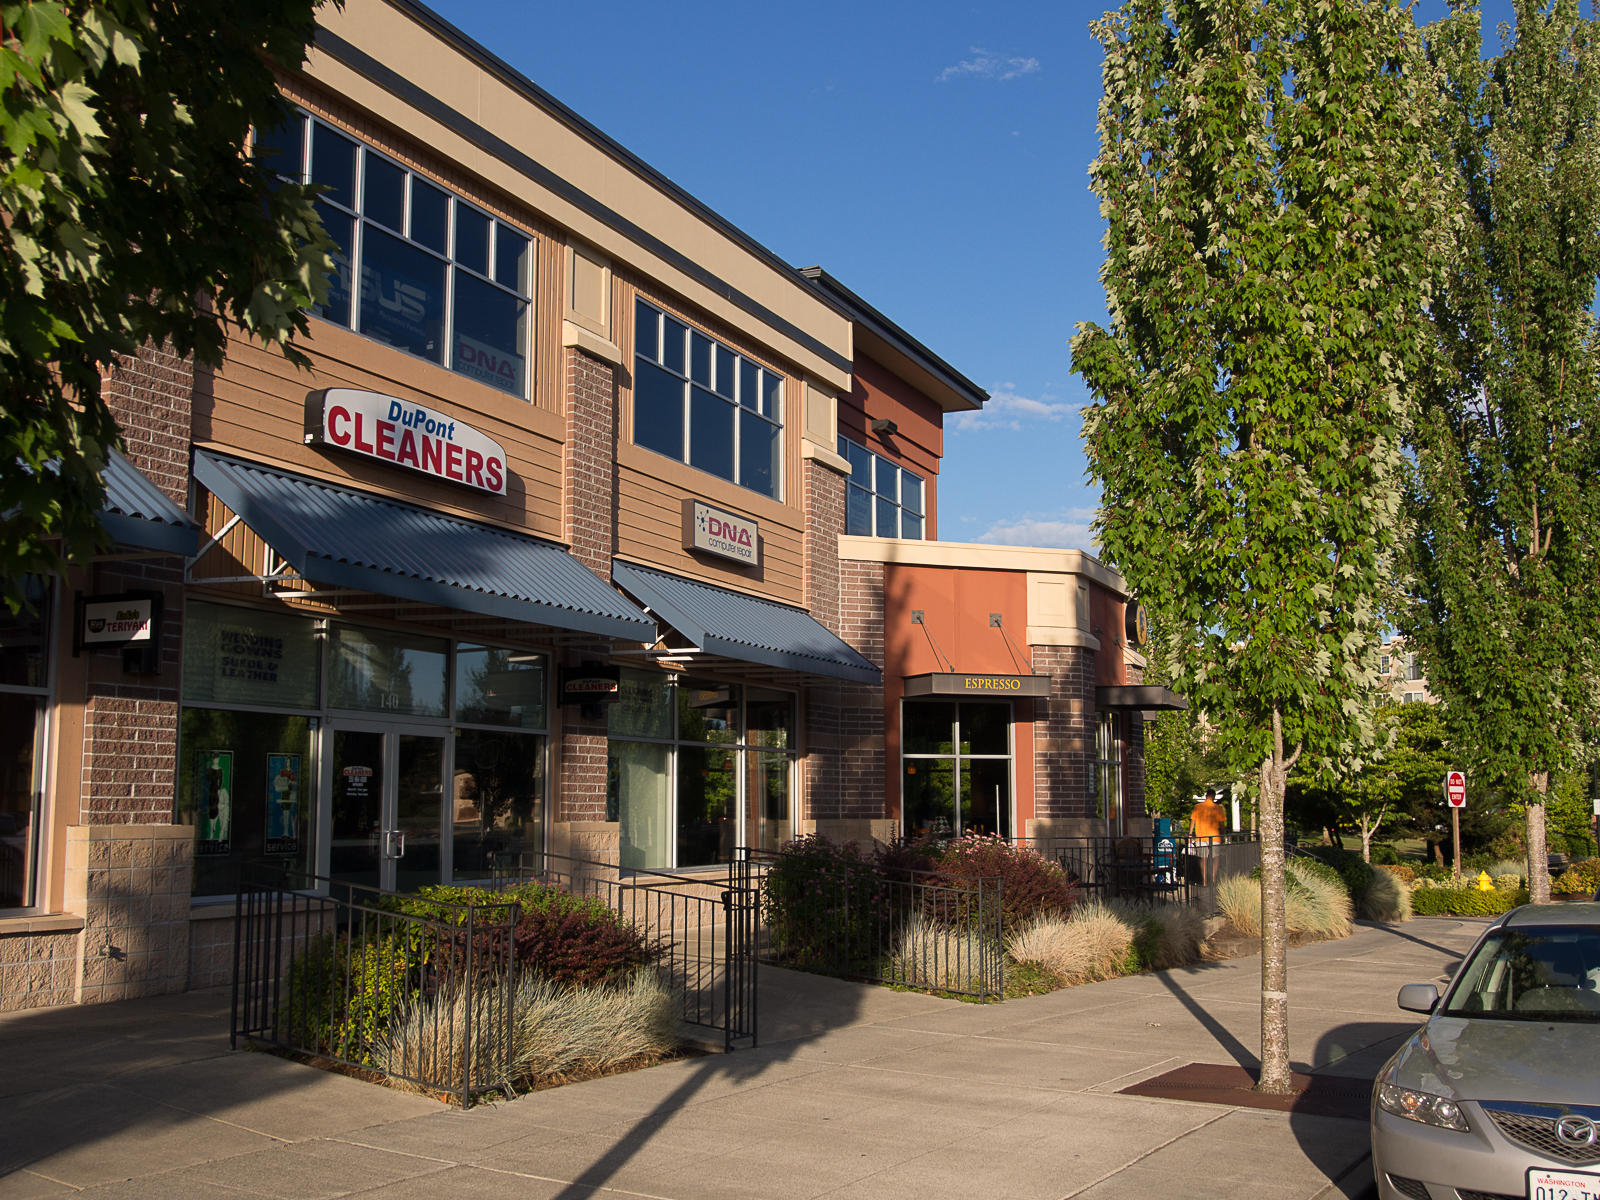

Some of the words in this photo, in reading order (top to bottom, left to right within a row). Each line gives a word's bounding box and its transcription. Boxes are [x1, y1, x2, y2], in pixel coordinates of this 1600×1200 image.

[458, 341, 516, 381] DNA
[458, 360, 494, 382] computer
[495, 373, 514, 390] repair
[388, 400, 455, 441] DuPont
[327, 405, 503, 492] CLEANERS
[708, 516, 752, 548] DNA
[708, 537, 736, 553] computer
[736, 547, 752, 558] repair
[106, 620, 148, 632] TERIYAKI
[221, 630, 283, 649] WEDDING
[221, 643, 283, 659] GOWNS
[222, 656, 263, 670] SUEDE
[267, 661, 279, 672] &
[222, 667, 277, 682] LEATHER
[566, 682, 617, 691] CLEANERS
[964, 677, 1021, 690] ESPRESSO
[380, 693, 399, 709] 140
[266, 841, 297, 852] service
[1537, 1177, 1586, 1188] WASHINGTON
